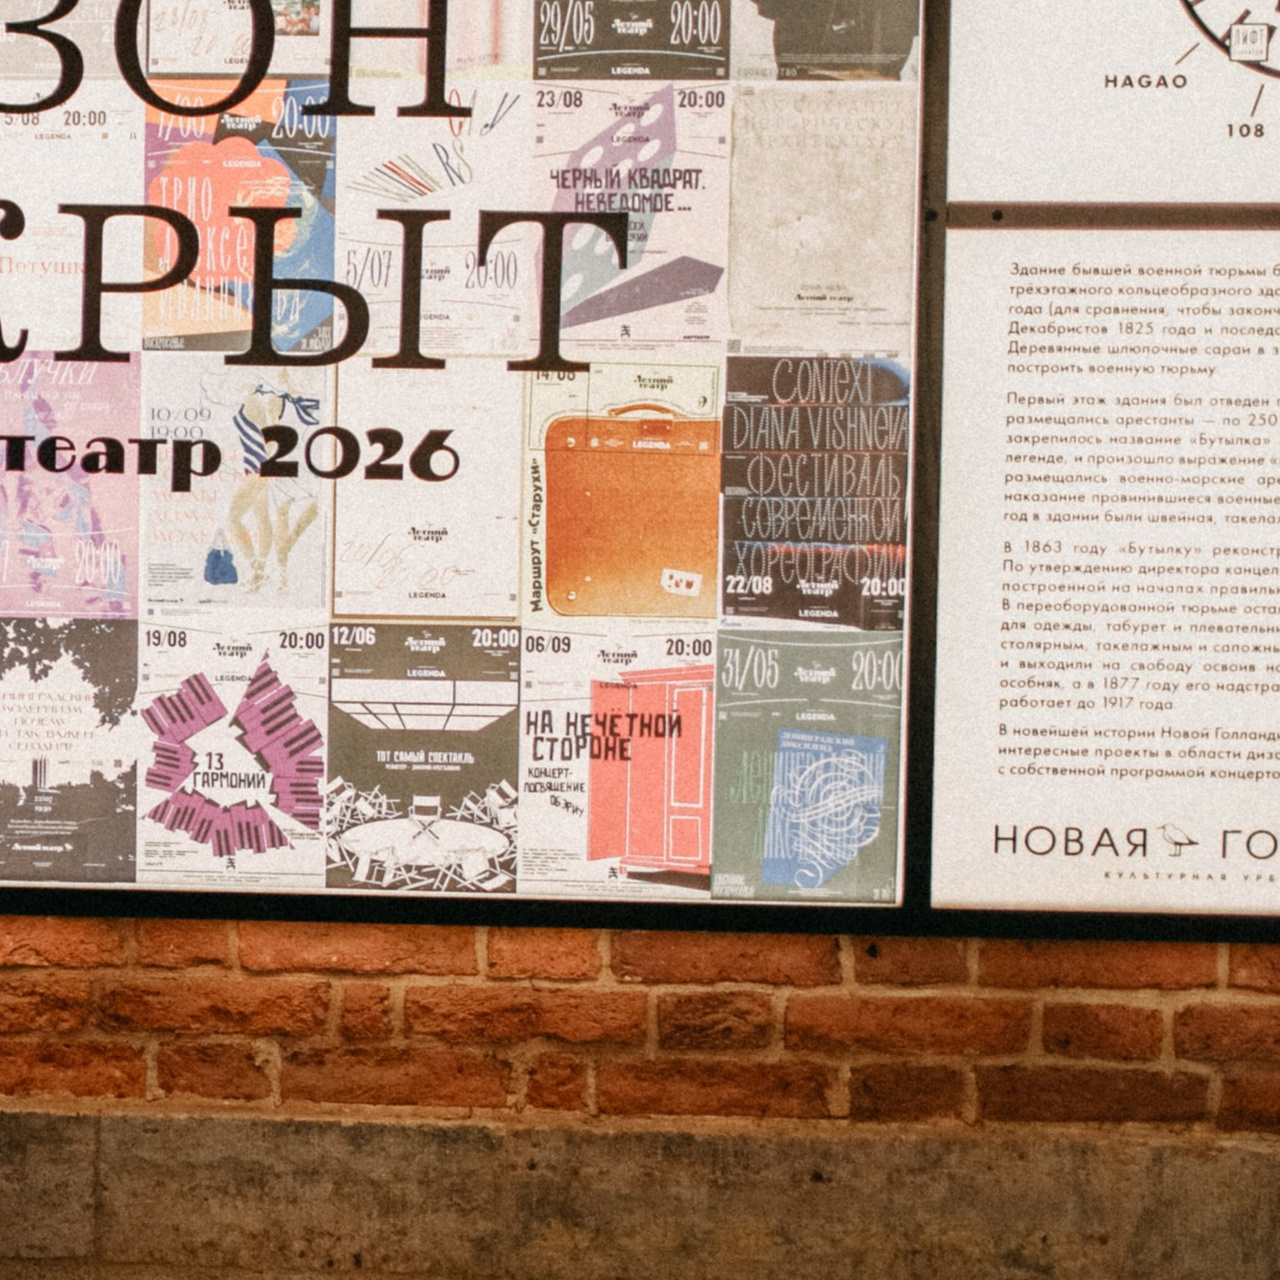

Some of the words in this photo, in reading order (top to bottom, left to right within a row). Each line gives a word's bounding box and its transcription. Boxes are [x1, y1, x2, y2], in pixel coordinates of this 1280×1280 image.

[671, 0, 720, 44] 20:00
[612, 67, 650, 75] LEGENDA
[1105, 75, 1188, 88] HAGAO
[536, 90, 583, 107] 23/08
[678, 91, 725, 108] 20:00
[63, 111, 106, 126] 20:00
[1228, 124, 1264, 138] 108
[550, 164, 620, 189] ЧЕРНЫЙ
[1011, 262, 1066, 276] Здание
[1073, 263, 1131, 275] бывшей
[1138, 264, 1201, 275] военной
[1209, 267, 1266, 280] тюрьмы
[1119, 283, 1252, 297] кольцеобразного
[1009, 304, 1042, 316] года
[1049, 303, 1079, 317] (для
[1177, 304, 1221, 315] чтобы
[1008, 321, 1108, 335] Декабристов
[1119, 322, 1153, 335] 1825
[1162, 325, 1195, 336] года
[1008, 341, 1100, 355] Деревянные
[1108, 345, 1197, 355] шлюпочные
[1205, 346, 1250, 357] сараи
[1007, 364, 1083, 375] построить
[1089, 365, 1154, 376] военную
[1007, 392, 1064, 406] Первый
[1072, 396, 1106, 404] этаж
[1115, 397, 1166, 406] здания
[1174, 394, 1202, 405] был
[1210, 398, 1269, 407] отведен
[733, 406, 799, 449] DIANA
[632, 441, 671, 449] LEGENDA
[1006, 436, 1101, 446] закрепилось
[1110, 436, 1181, 445] название
[1190, 433, 1270, 448] «Бутылка»
[259, 424, 460, 482] 2026
[528, 459, 543, 534] «Старухи»
[1025, 541, 1062, 553] 1863
[1074, 545, 1107, 556] году
[1119, 543, 1202, 556] «Бутылку»
[530, 539, 543, 612] Маршрут
[1004, 560, 1023, 572] По
[1030, 563, 1132, 574] утверждению
[1138, 564, 1219, 576] директора
[726, 575, 772, 594] 22/08
[861, 577, 906, 596] 20:00
[408, 591, 446, 599] LEGENDA
[799, 610, 838, 618] LEGENDA
[146, 630, 187, 647] 19/08
[279, 632, 325, 649] 20:00
[332, 627, 376, 645] 12/06
[472, 629, 519, 647] 20:00
[526, 636, 571, 652] 06/09
[666, 639, 712, 655] 20:00
[407, 669, 446, 677] LEGENDA
[722, 646, 779, 690] 31/05
[1103, 678, 1139, 689] 1877
[1146, 681, 1178, 693] году
[1186, 682, 1210, 691] его
[526, 710, 553, 735] НА
[566, 708, 682, 738] НЕЧЁТНОЙ
[796, 712, 835, 720] LEGENDA
[1013, 725, 1088, 737] новейшей
[1094, 728, 1155, 740] истории
[1161, 727, 1209, 740] Новой
[533, 733, 631, 761] СТОРОНЕ
[998, 747, 1089, 758] интересные
[1095, 747, 1159, 759] проекты
[1179, 746, 1241, 759] области
[205, 752, 224, 770] 13
[377, 750, 391, 763] ТОТ
[394, 750, 426, 763] САМЫЙ
[428, 752, 474, 764] СПЕКТАКЛЬ
[193, 772, 266, 789] ГАРМОНИИ
[528, 768, 573, 778] КОНЦЕРТ-
[524, 781, 585, 792] ПОСВЯЩЕНИЕ
[994, 824, 1147, 858] НОВАЯ
[1222, 830, 1278, 860] ГО
[1104, 872, 1227, 880] КУЛЬТУРНАЯ
